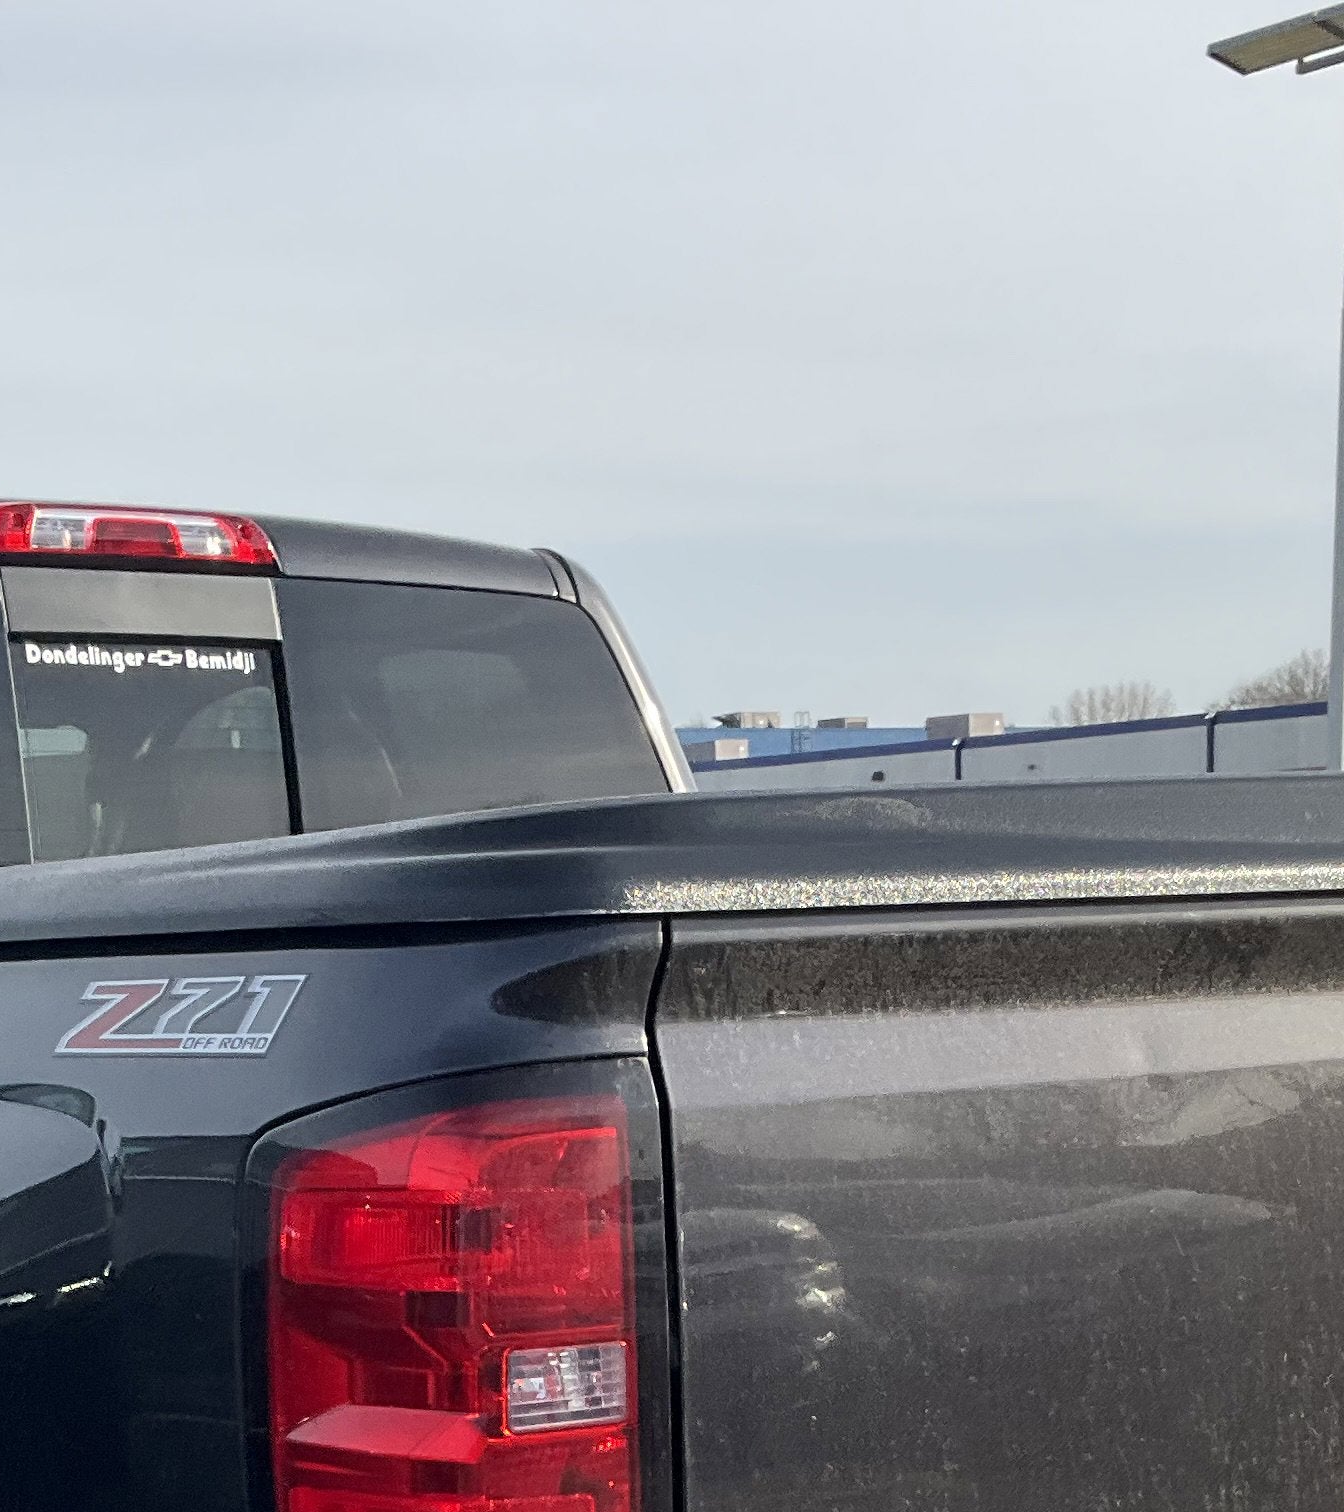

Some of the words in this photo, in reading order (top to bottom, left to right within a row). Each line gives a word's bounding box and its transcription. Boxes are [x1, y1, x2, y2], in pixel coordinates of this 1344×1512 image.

[25, 643, 145, 673] Dondelinger
[185, 649, 256, 675] Bemidji
[55, 974, 308, 1053] Z71
[182, 1037, 215, 1050] OFF
[218, 1036, 269, 1050] ROAD
